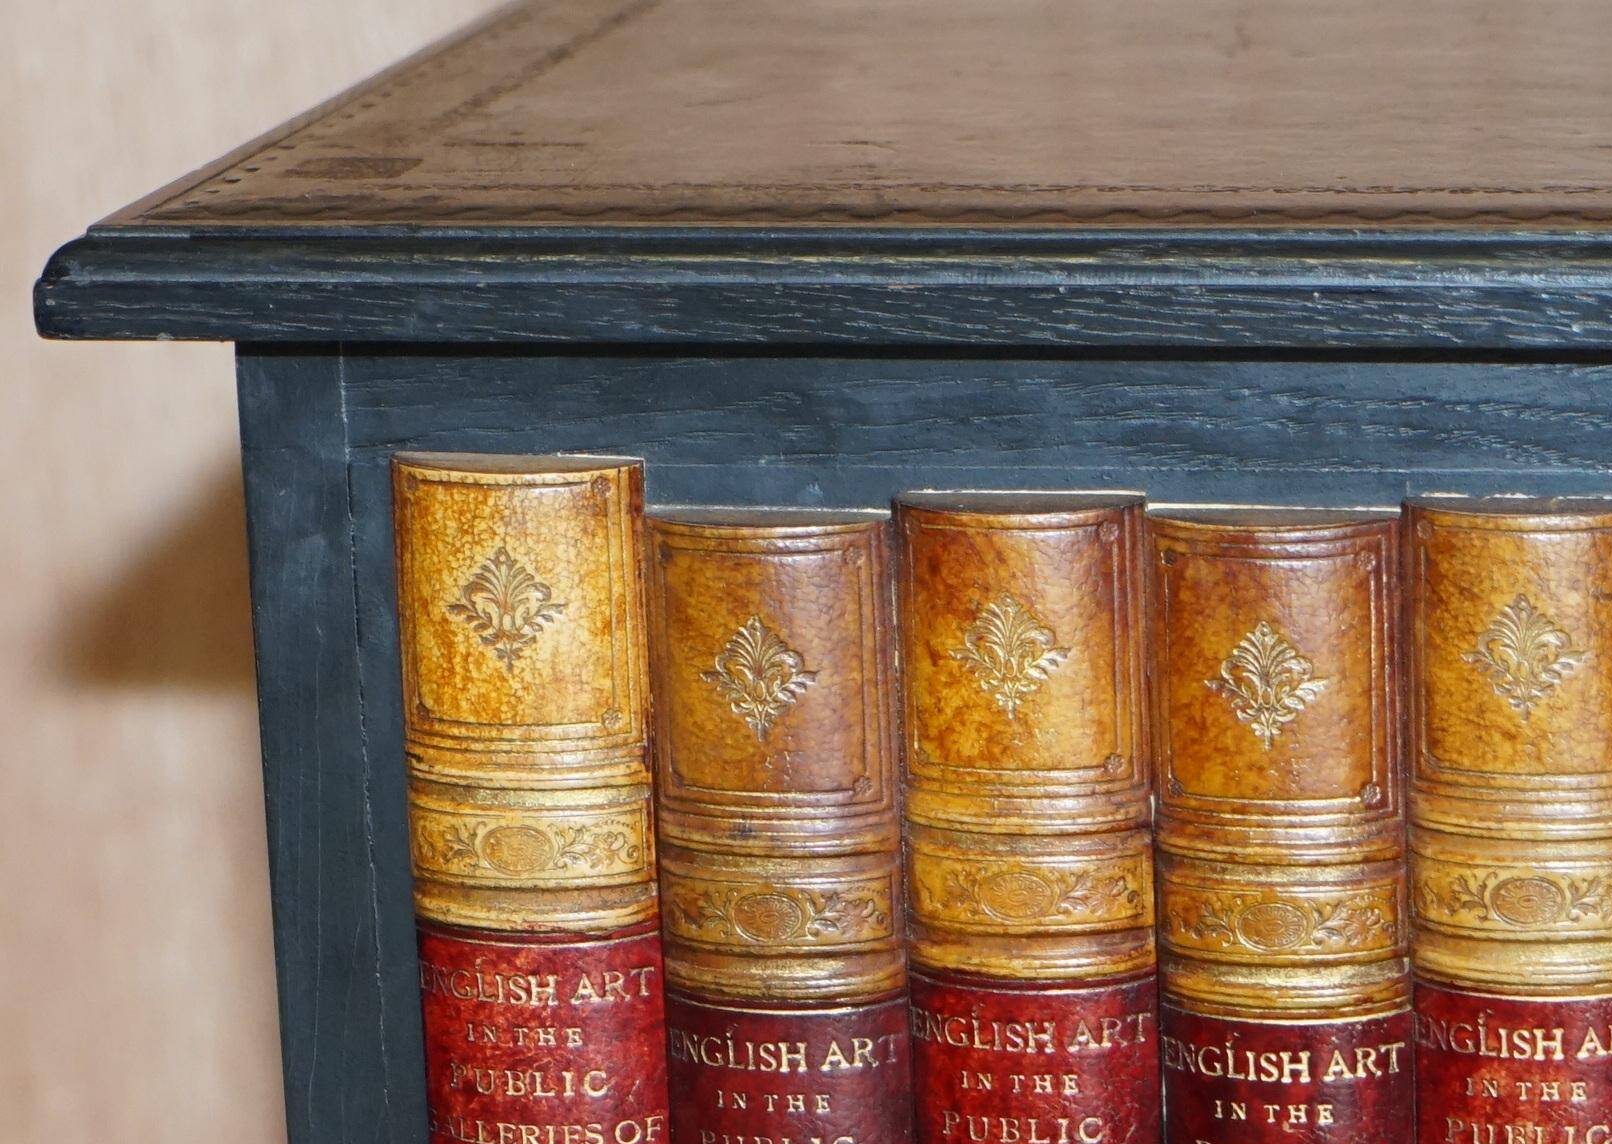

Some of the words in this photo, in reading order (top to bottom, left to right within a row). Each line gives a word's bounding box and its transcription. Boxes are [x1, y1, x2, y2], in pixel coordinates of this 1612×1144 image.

[419, 960, 560, 1006] ENGLISH
[571, 967, 655, 1004] ART
[467, 1024, 497, 1042] IN
[514, 1027, 583, 1047] THE
[910, 1006, 1056, 1053] ENGLISH
[1067, 1013, 1151, 1053] ART
[1413, 1012, 1564, 1060] ENGLISH
[669, 1027, 808, 1073] ENGLISH
[820, 1035, 901, 1072] ART
[1162, 1036, 1311, 1083] ENGLISH
[1323, 1042, 1405, 1082] ART
[451, 1063, 609, 1097] PUBLIC
[961, 1071, 992, 1090] IN
[1009, 1074, 1079, 1095] THE
[1466, 1078, 1498, 1098] IN
[1516, 1082, 1587, 1103] THE
[717, 1090, 746, 1109] IN
[764, 1095, 831, 1113] THE
[1215, 1101, 1247, 1120] IN
[1264, 1104, 1334, 1125] THE
[942, 1111, 1103, 1144] PUBLIC
